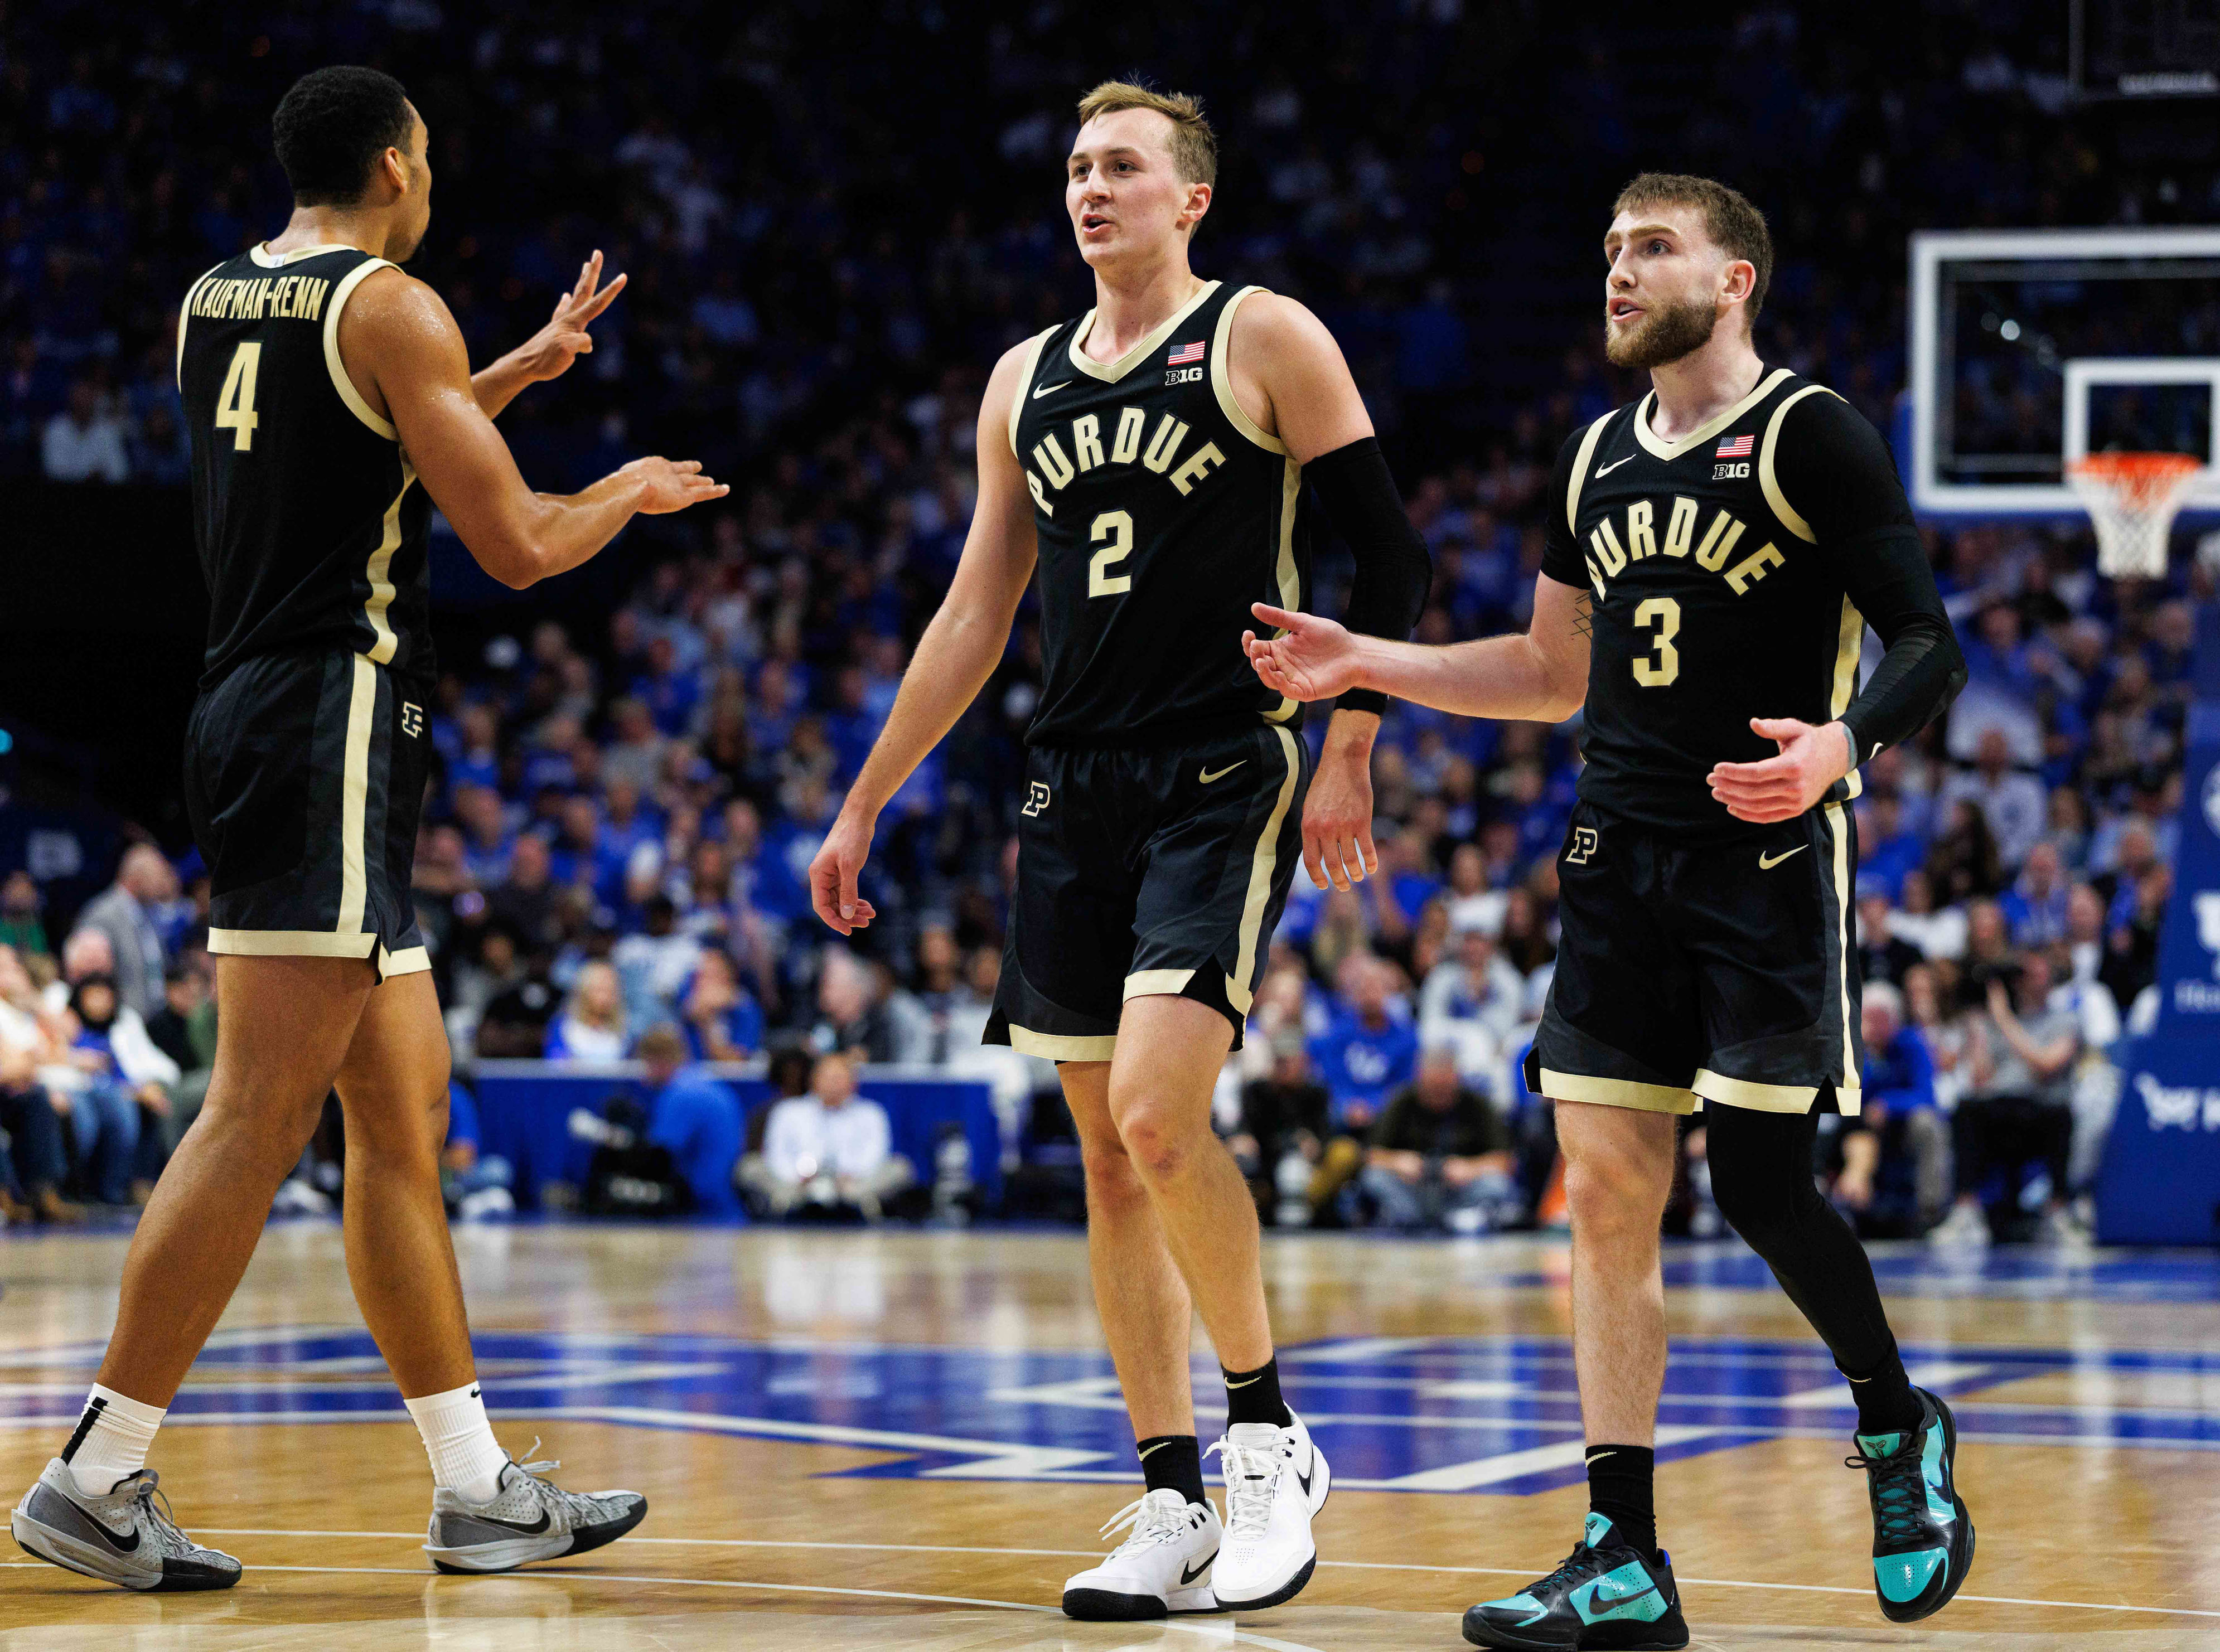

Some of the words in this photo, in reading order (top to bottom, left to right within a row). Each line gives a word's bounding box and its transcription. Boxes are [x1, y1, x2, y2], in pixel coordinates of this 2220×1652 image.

[191, 276, 330, 321] KAUFMAN-RENN
[216, 342, 262, 451] 4
[1026, 407, 1227, 519] PURDUE
[1089, 510, 1133, 598] 2
[1632, 597, 1681, 687] 3
[1020, 781, 1051, 817] P
[1565, 826, 1598, 865] P
